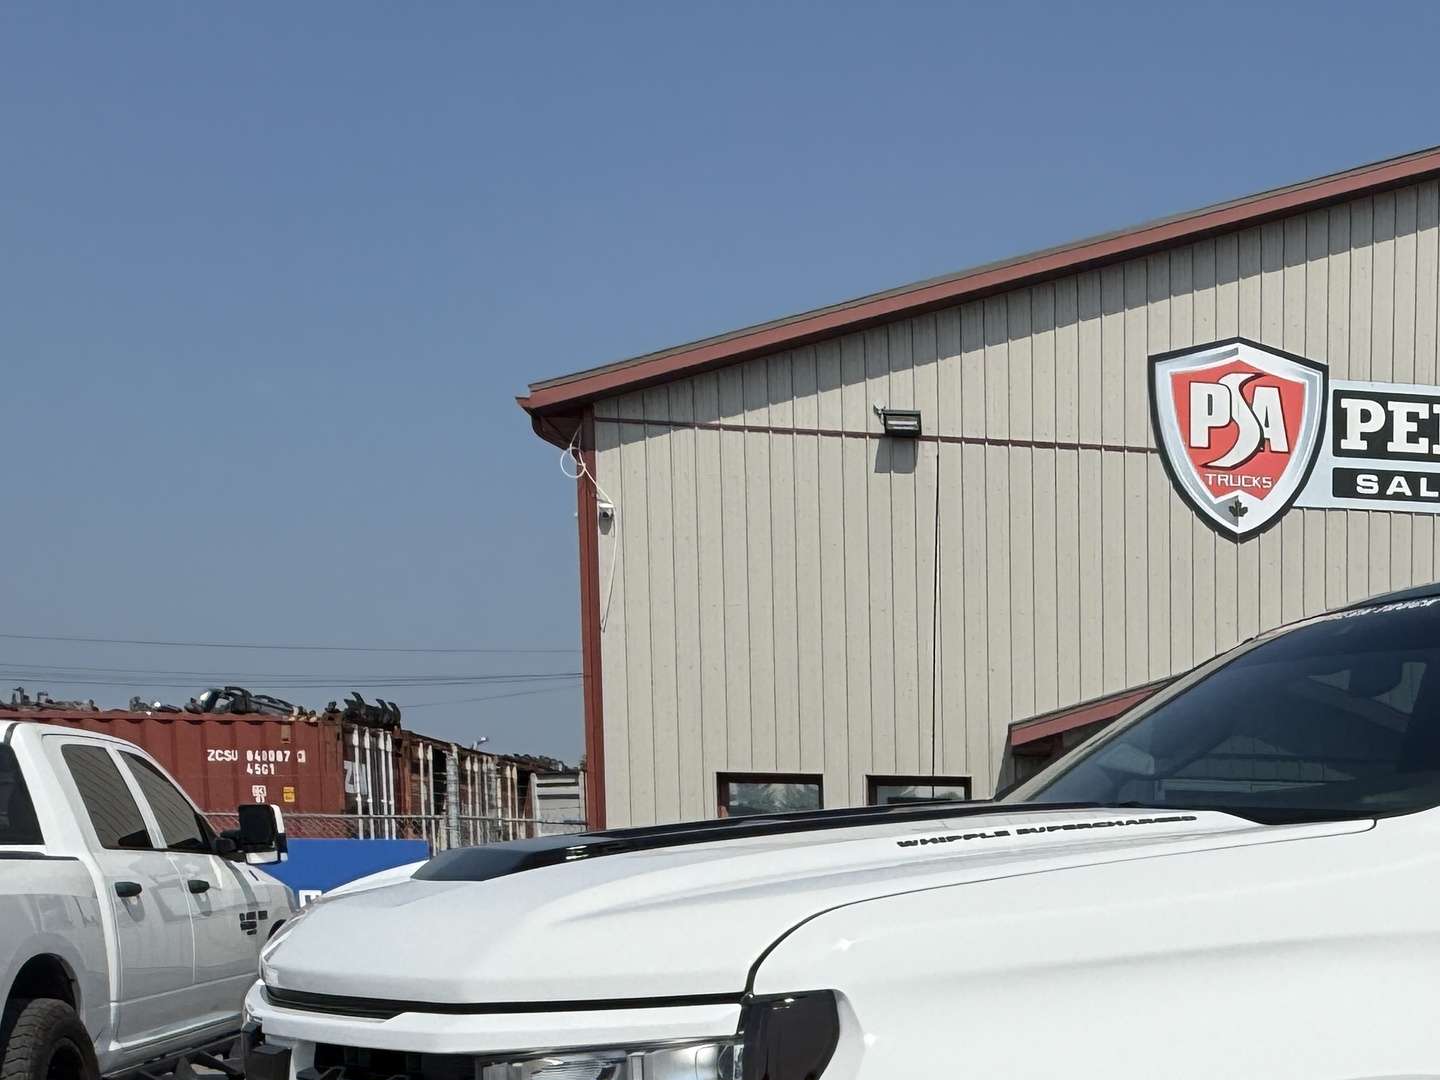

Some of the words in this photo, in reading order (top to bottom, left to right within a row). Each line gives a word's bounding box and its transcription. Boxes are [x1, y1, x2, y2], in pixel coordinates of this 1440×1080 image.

[1189, 372, 1290, 470] PSA
[1205, 473, 1273, 488] TRUCKS
[207, 749, 238, 762] ZCSU
[246, 763, 275, 775] 45G1
[897, 830, 1010, 847] WHIPPLE
[1016, 815, 1197, 836] SUPERCHARGED
